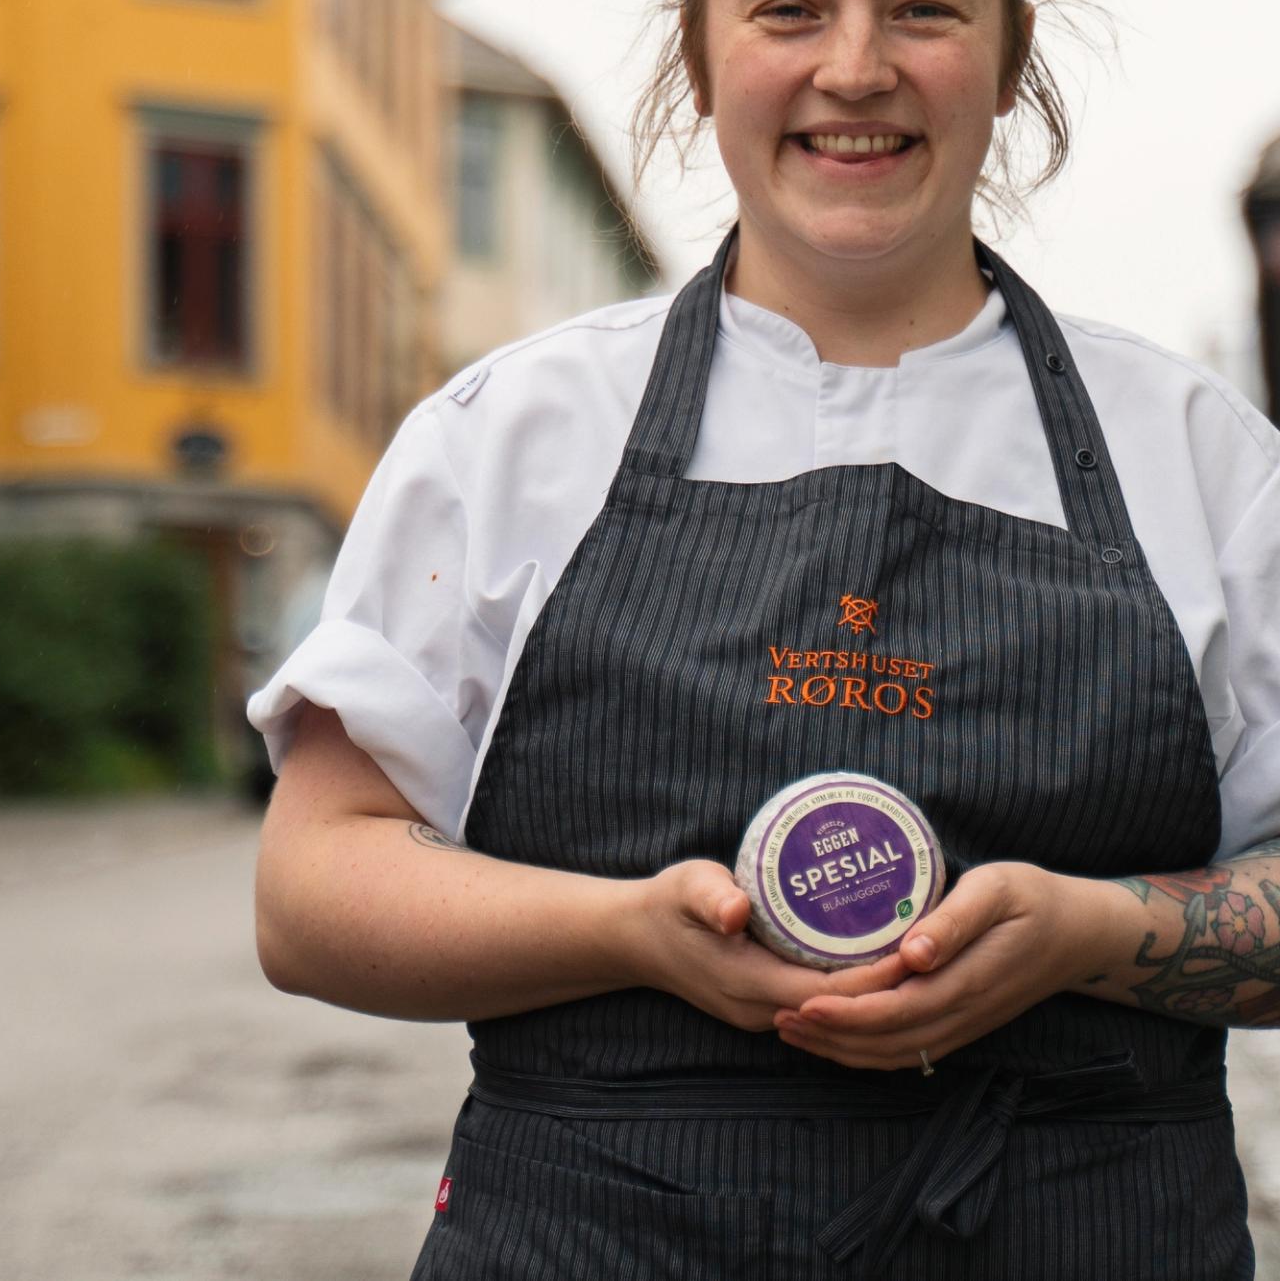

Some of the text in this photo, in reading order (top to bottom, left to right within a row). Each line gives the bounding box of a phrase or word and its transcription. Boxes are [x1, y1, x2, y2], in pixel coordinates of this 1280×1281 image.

[768, 646, 935, 680] VERTSHUSET
[764, 676, 936, 720] RØROS
[858, 791, 879, 803] EGGEN
[812, 827, 860, 857] EGGEN
[790, 841, 903, 896] SPESIAL
[822, 880, 892, 913] BLÅMUGGOST
